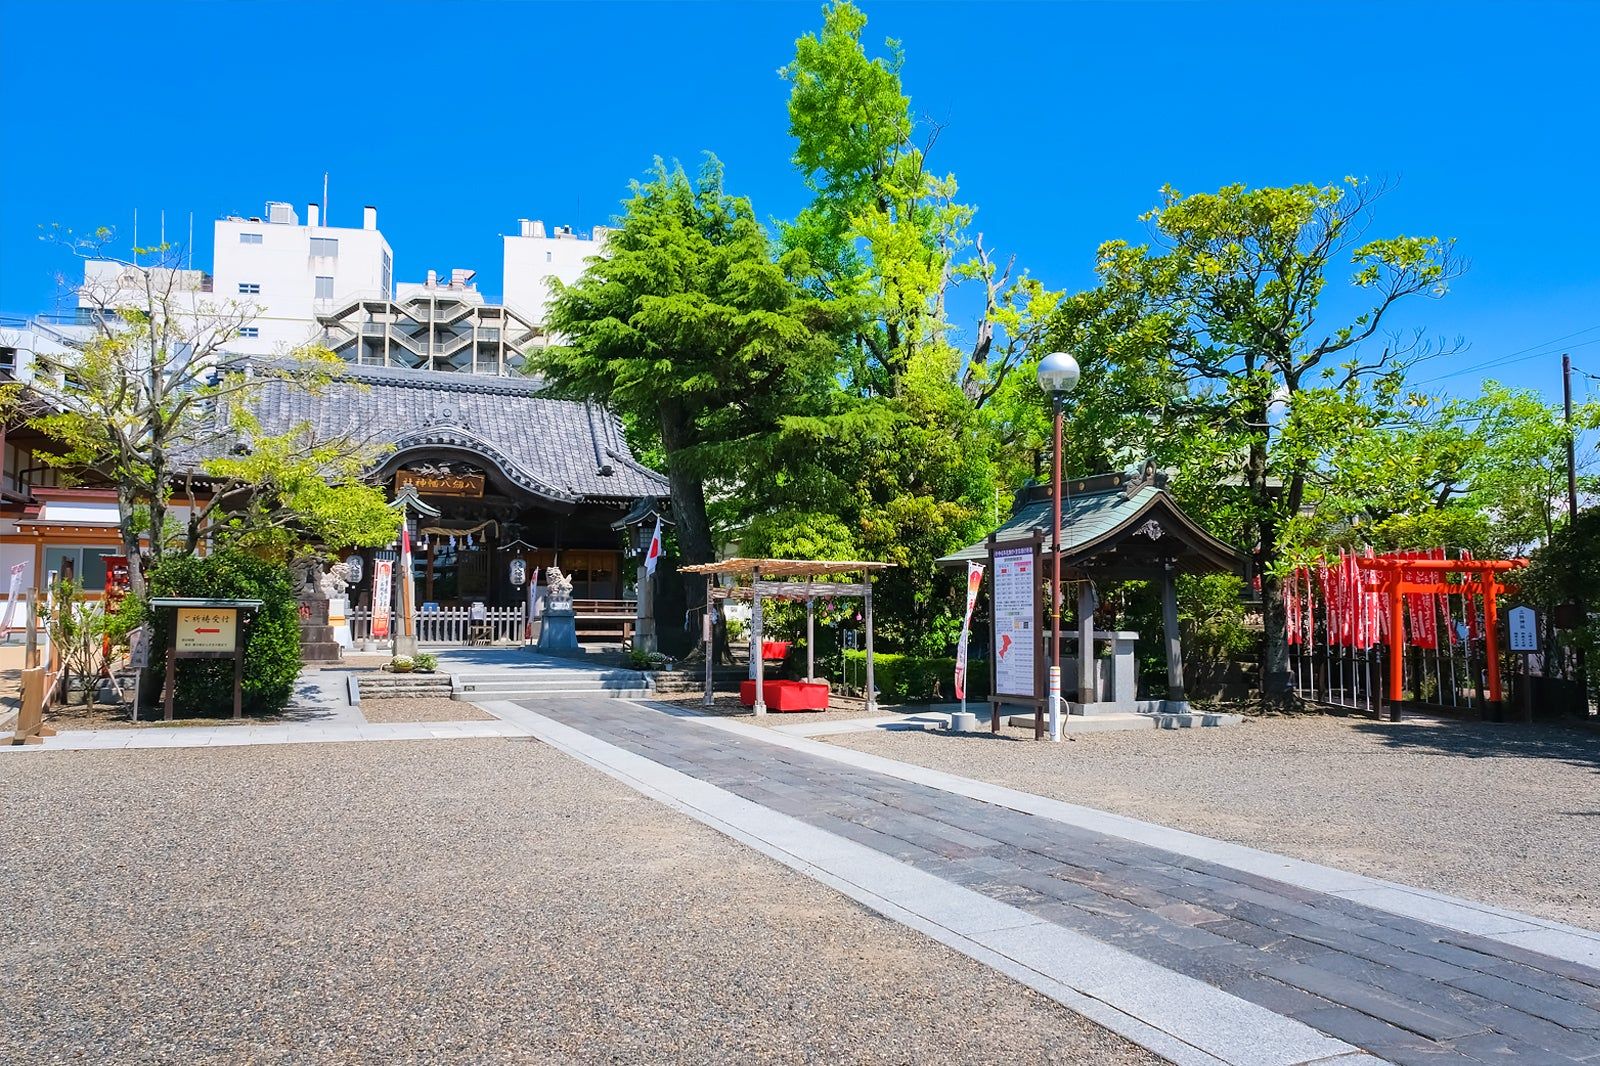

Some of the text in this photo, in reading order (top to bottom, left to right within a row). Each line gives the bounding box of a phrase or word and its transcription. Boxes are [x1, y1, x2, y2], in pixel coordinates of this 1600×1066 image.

[183, 614, 230, 624] ご祈祷受付
